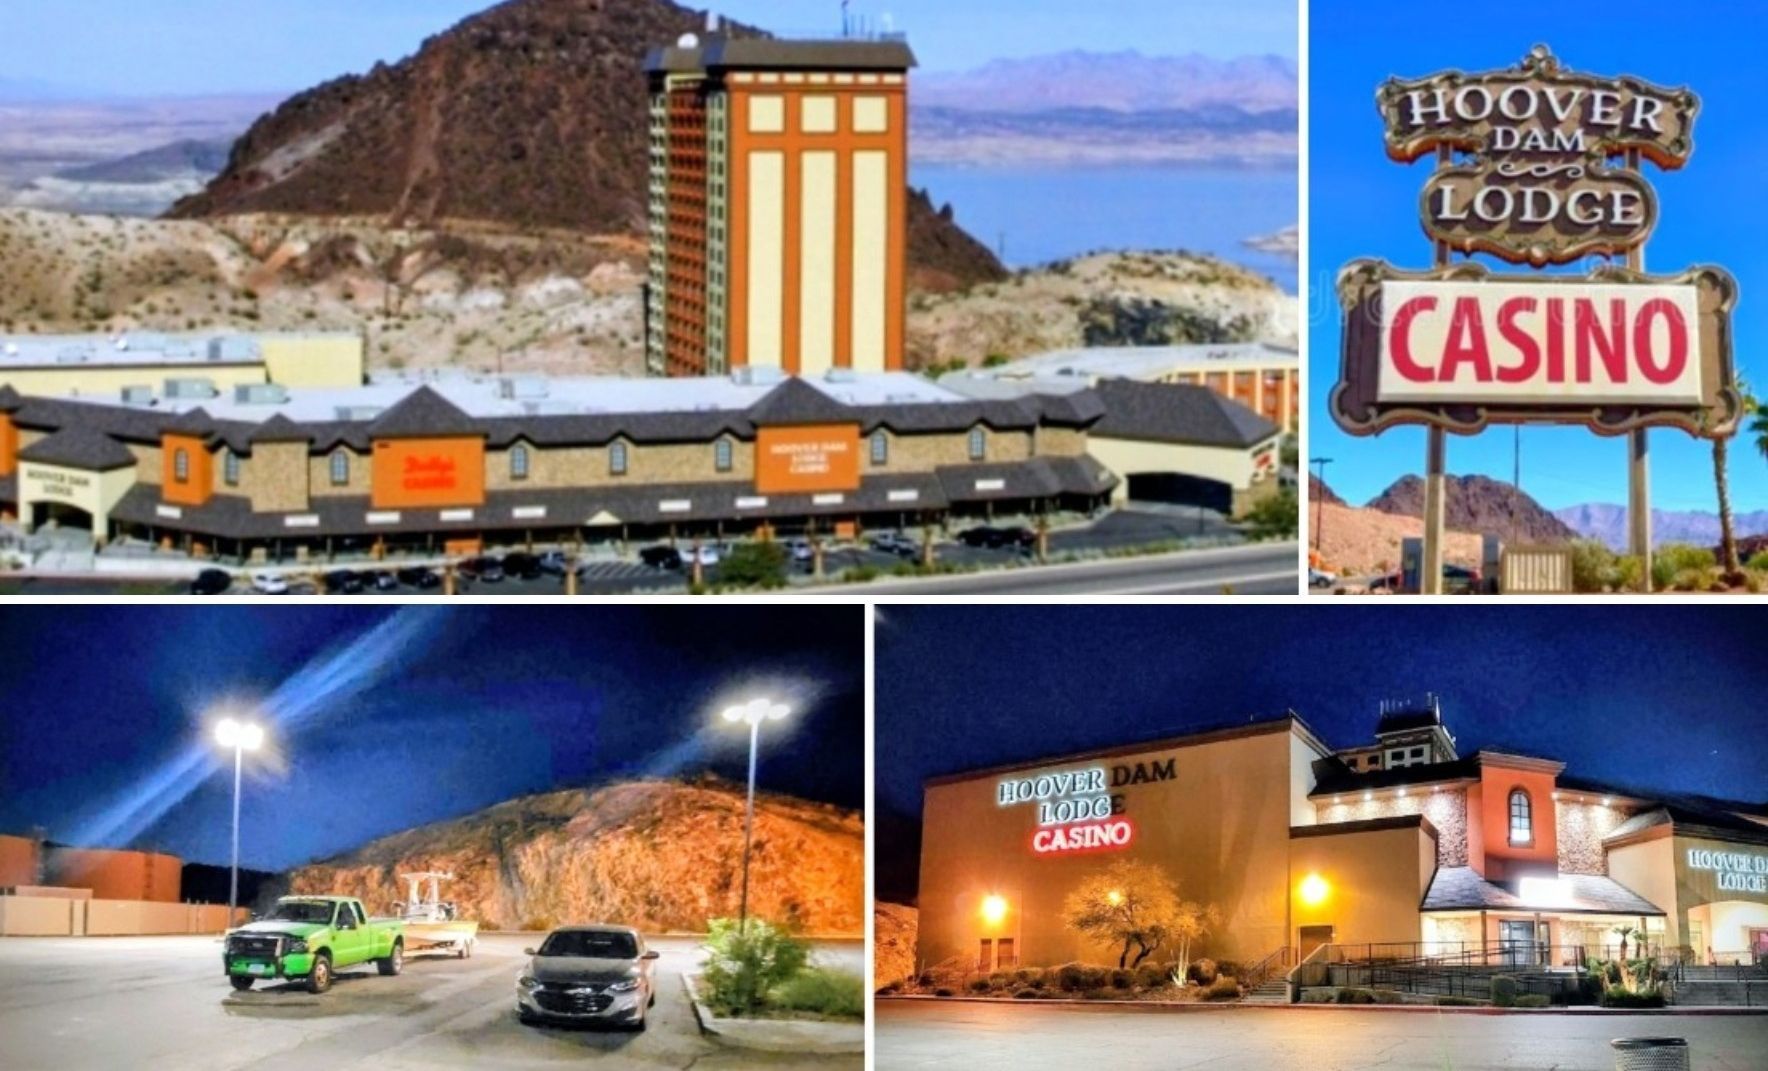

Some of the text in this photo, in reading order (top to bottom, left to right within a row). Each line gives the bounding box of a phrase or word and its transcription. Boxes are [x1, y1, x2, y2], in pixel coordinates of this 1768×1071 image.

[1408, 85, 1663, 133] HOOVER
[1493, 126, 1585, 151] DAM
[1437, 184, 1645, 225] LODGE
[1389, 296, 1688, 384] CASINO
[998, 758, 1177, 804] HOOVER DAM
[1040, 793, 1127, 825] LODGE
[1033, 822, 1132, 853] CASINO
[1688, 850, 1755, 872] HOOVER
[1718, 872, 1766, 892] LODGE
